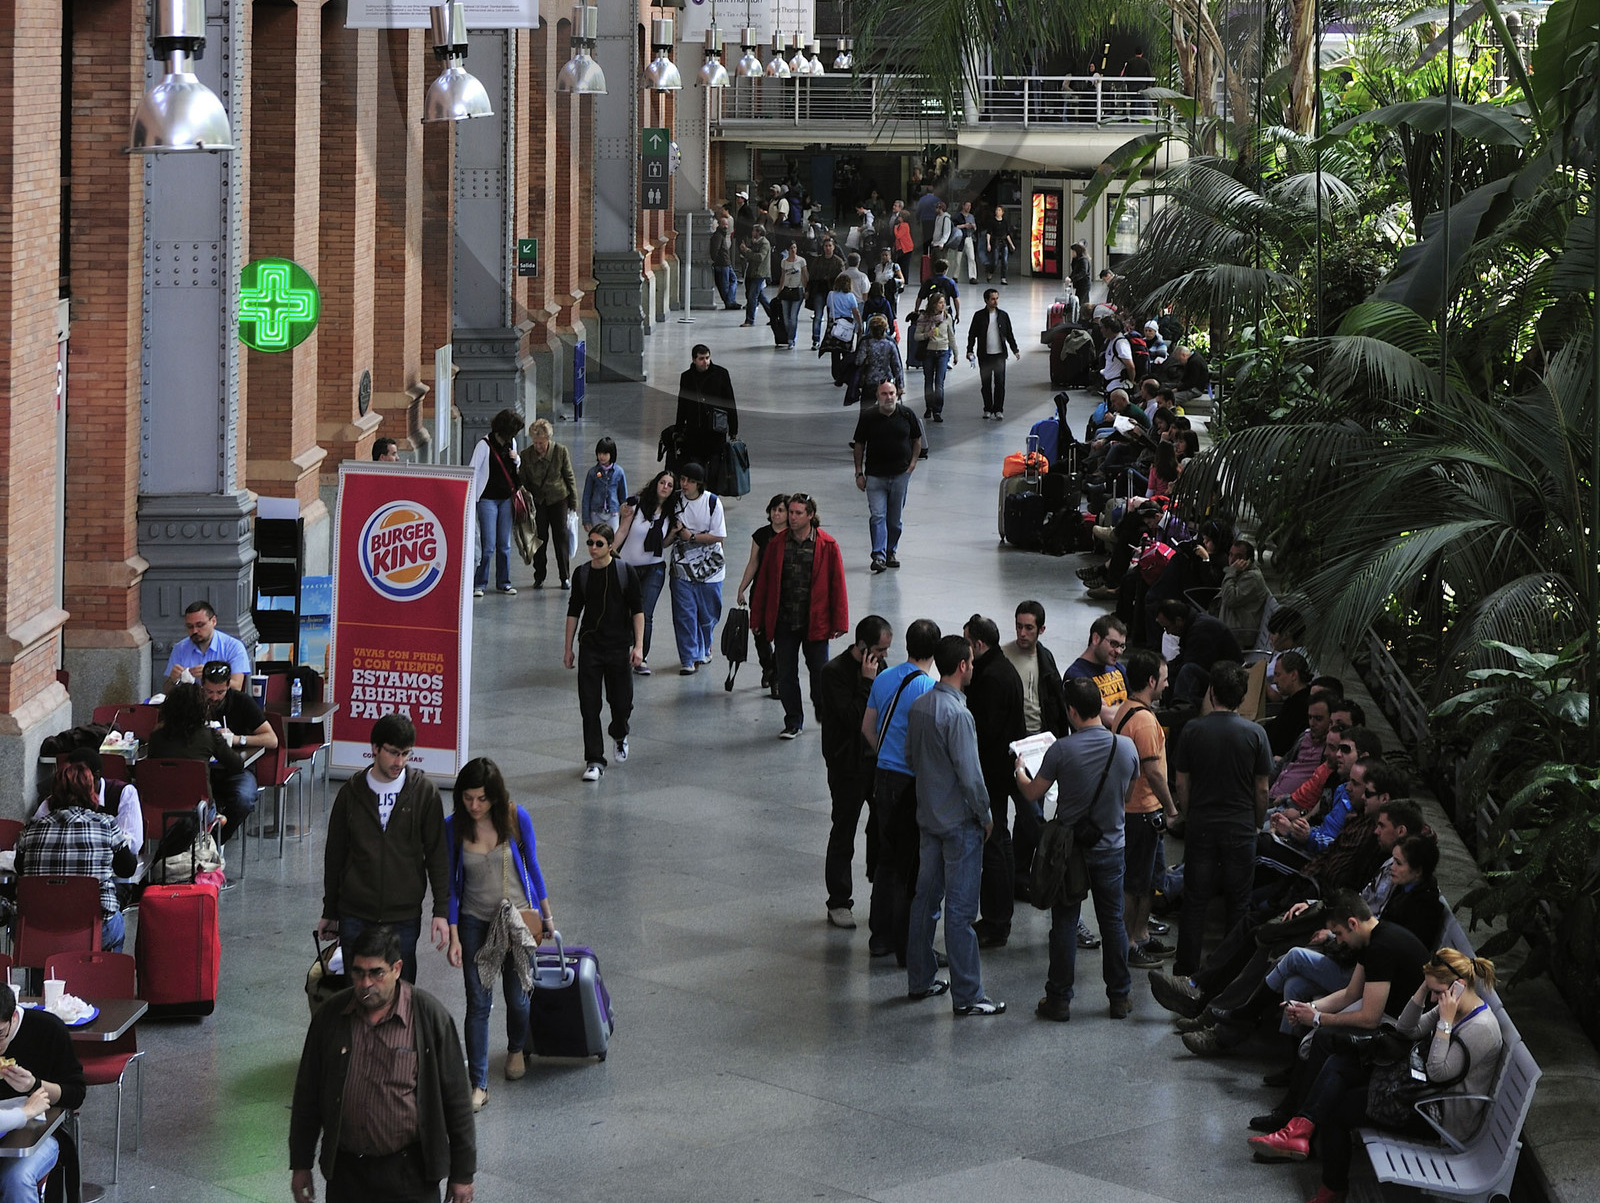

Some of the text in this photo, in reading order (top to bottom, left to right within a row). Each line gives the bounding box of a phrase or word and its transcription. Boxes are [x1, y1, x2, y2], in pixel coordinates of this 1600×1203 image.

[371, 521, 435, 553] BURGER
[373, 537, 437, 577] KING
[352, 657, 444, 674] O CON TIEMPO
[353, 647, 444, 663] VAYAS CON PRISA
[351, 668, 444, 690] ESTAMOS
[350, 685, 443, 706] ABIERTOS
[349, 700, 442, 725] PARA TI
